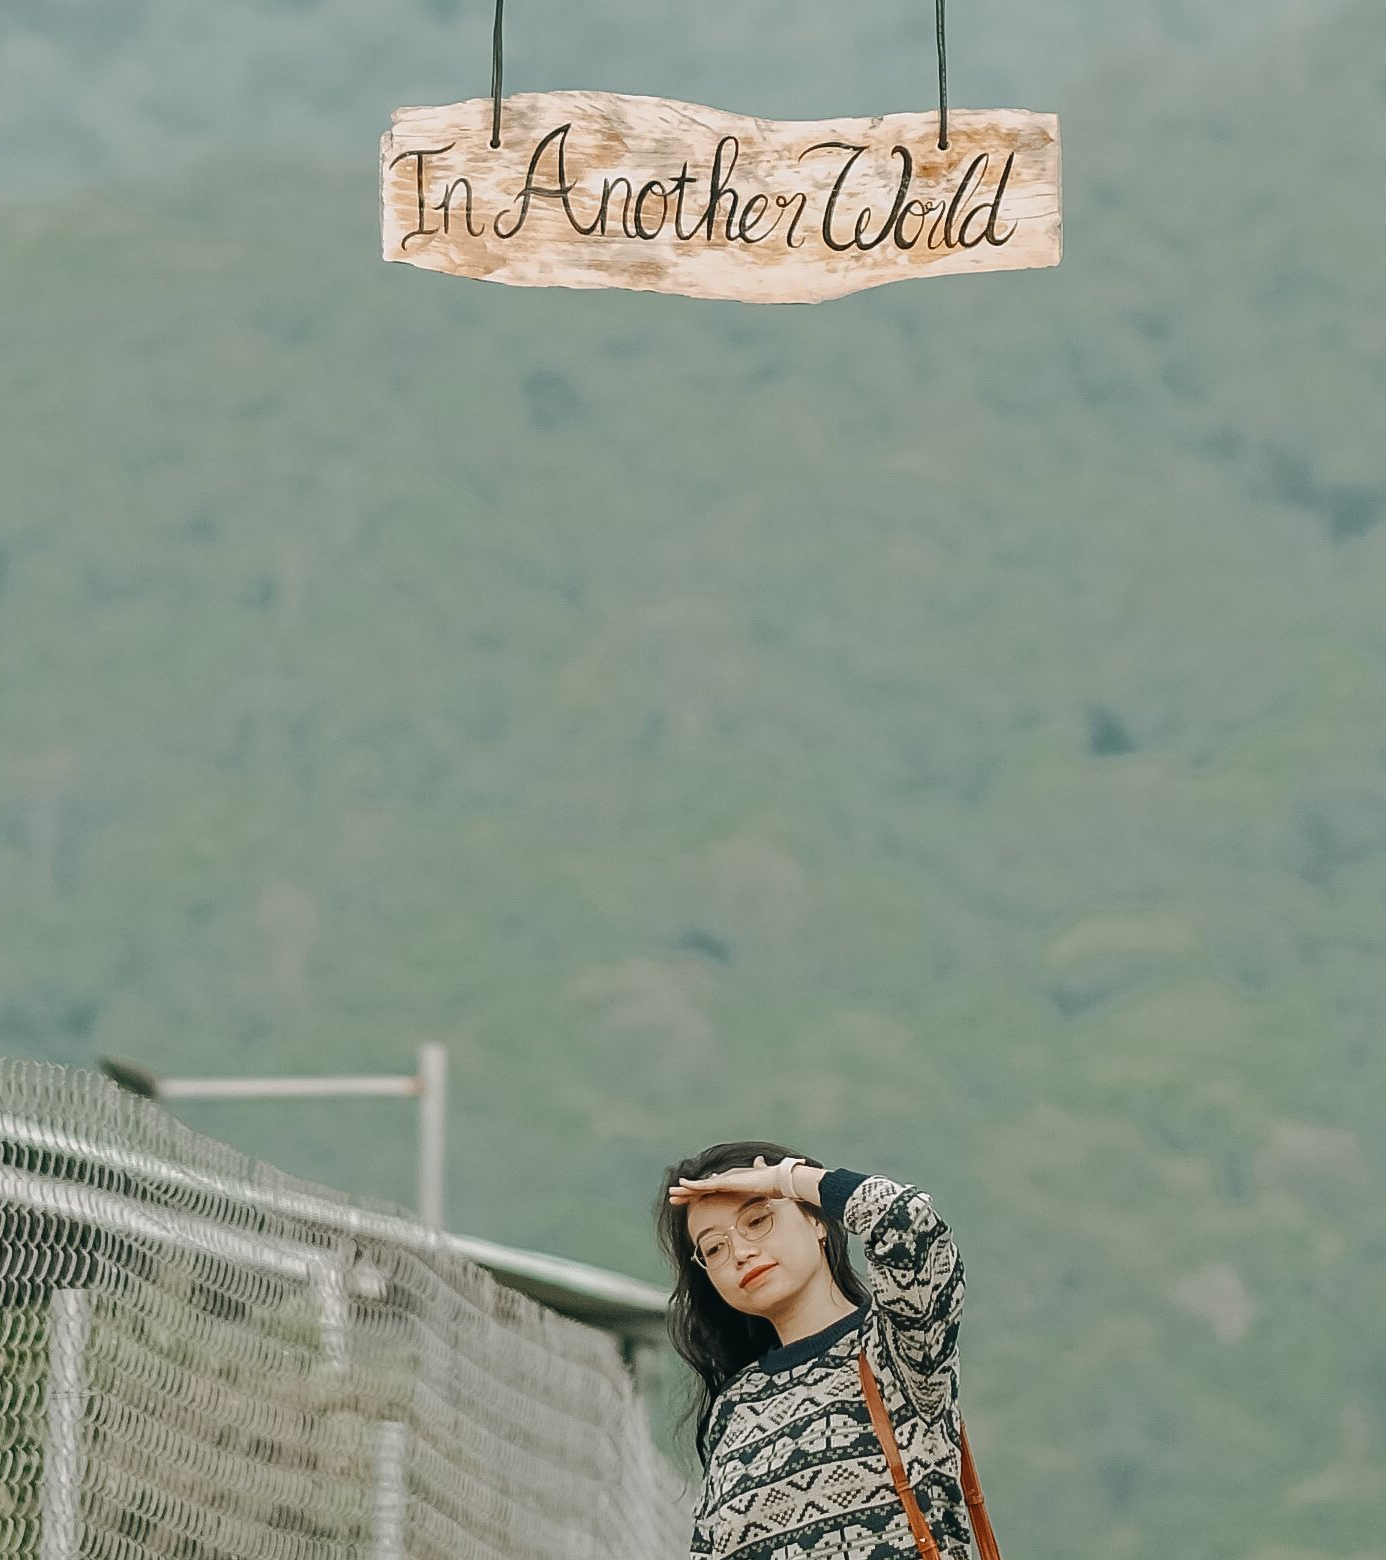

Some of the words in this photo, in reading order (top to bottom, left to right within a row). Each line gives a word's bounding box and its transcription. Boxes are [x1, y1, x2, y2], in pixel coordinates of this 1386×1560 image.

[389, 142, 485, 251] In
[494, 123, 809, 249] Another
[797, 142, 1019, 252] World
